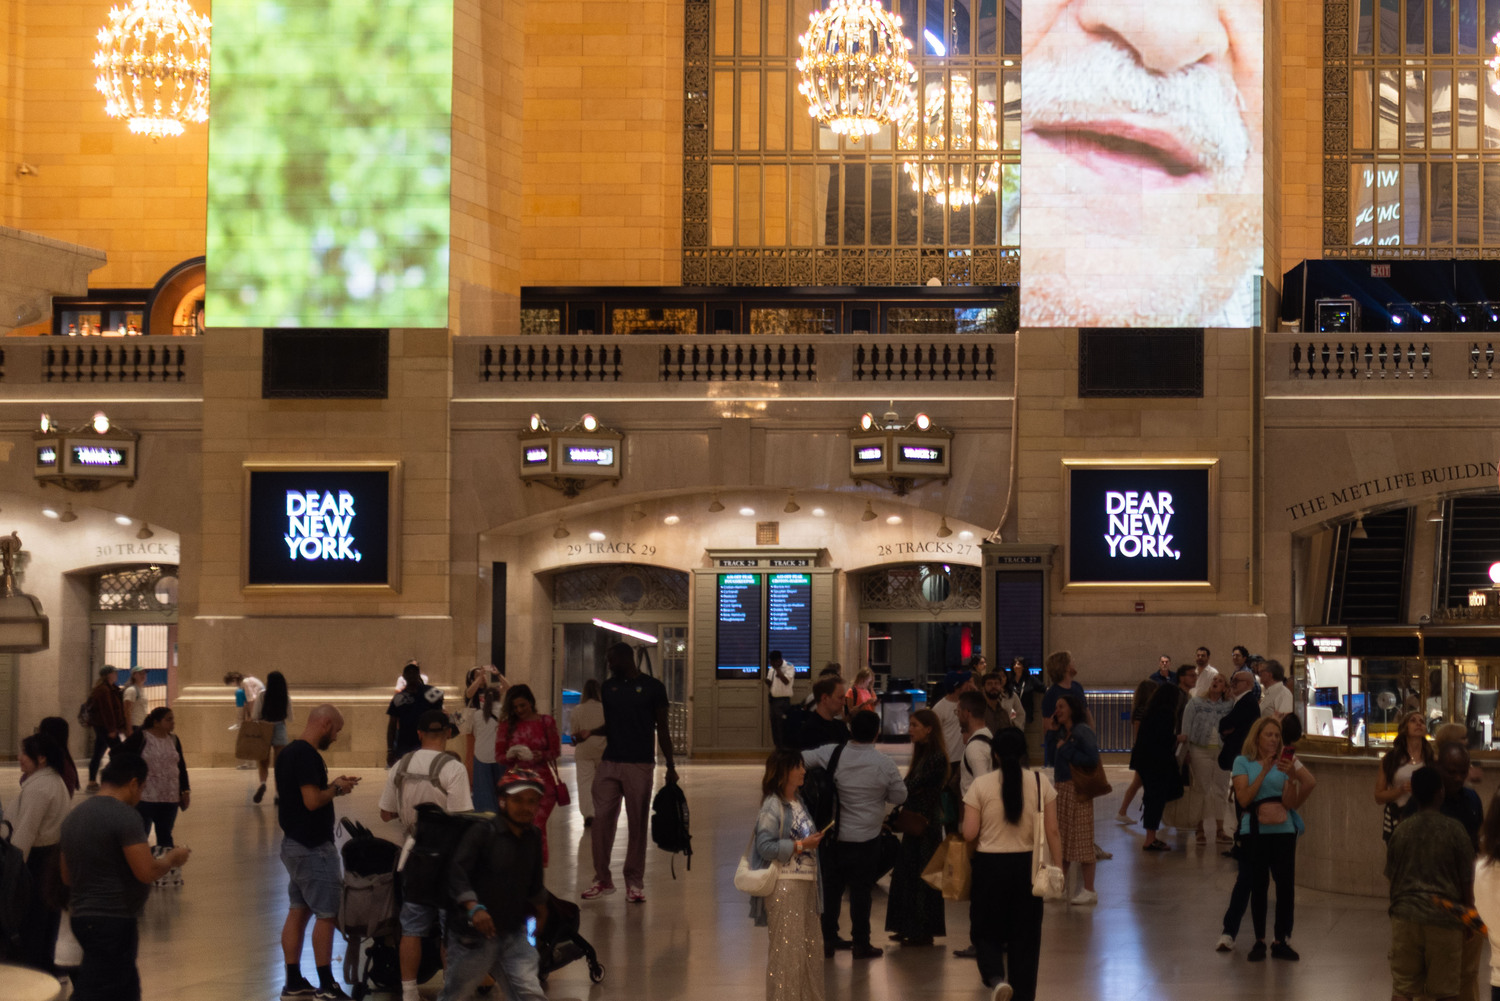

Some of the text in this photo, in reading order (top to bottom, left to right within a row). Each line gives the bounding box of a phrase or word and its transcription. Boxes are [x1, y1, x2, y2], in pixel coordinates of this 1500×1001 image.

[1373, 264, 1390, 277] EXIT
[1285, 460, 1500, 520] THE METLIFE BUILDIN
[286, 490, 356, 516] DEAR
[1105, 491, 1174, 514] DEAR
[289, 515, 353, 537] NEW
[1108, 513, 1171, 536] NEW
[96, 542, 180, 558] 30 TRACK 3
[284, 534, 362, 562] YORK,
[567, 541, 657, 556] 29 TRACK 29
[877, 541, 972, 557] 28 TRACKS 27
[1104, 535, 1181, 560] YORK,
